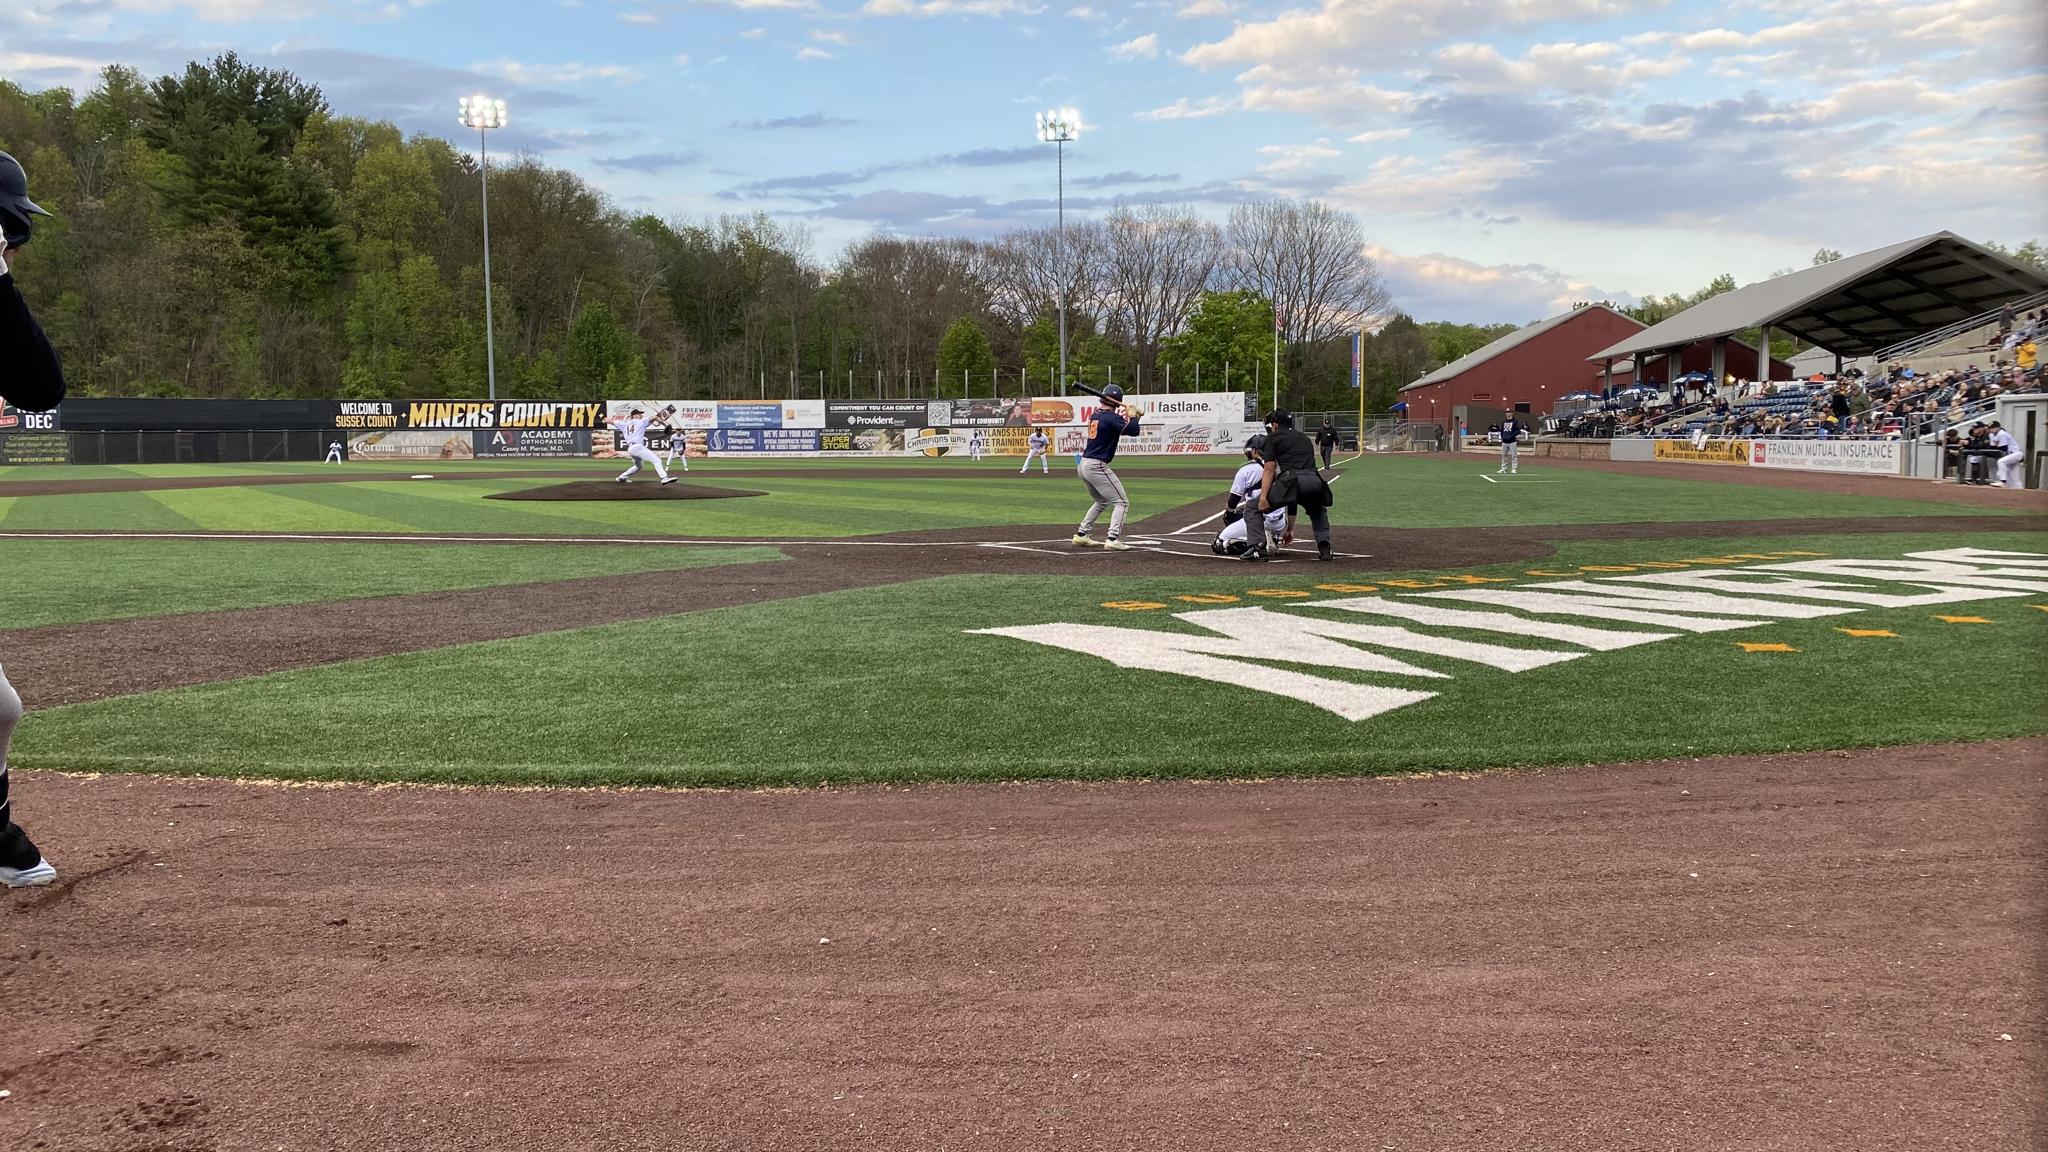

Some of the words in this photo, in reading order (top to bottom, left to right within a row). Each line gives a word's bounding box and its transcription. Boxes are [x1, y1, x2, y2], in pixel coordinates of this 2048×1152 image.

[340, 403, 380, 415] WELCOME
[382, 403, 392, 415] TO
[25, 414, 53, 429] DEC
[335, 415, 366, 428] SUSSEX
[367, 415, 398, 428] COUNTY
[408, 403, 495, 428] MINERS
[500, 403, 600, 428] COUNTRY
[856, 416, 894, 424] Provident
[520, 431, 574, 439] ACADEMY
[353, 441, 395, 455] Corona
[907, 436, 949, 448] CHAMPIONS
[992, 438, 1025, 447] TRAINING
[1166, 444, 1185, 452] TIRE
[401, 446, 430, 454] AWAITS
[1769, 443, 1803, 456] FRANKLIN
[1806, 444, 1837, 457] MUTUAL
[1840, 444, 1893, 458] INSURANCE
[1101, 573, 1516, 612] SUSSEX
[1524, 550, 1833, 577] COUNTY
